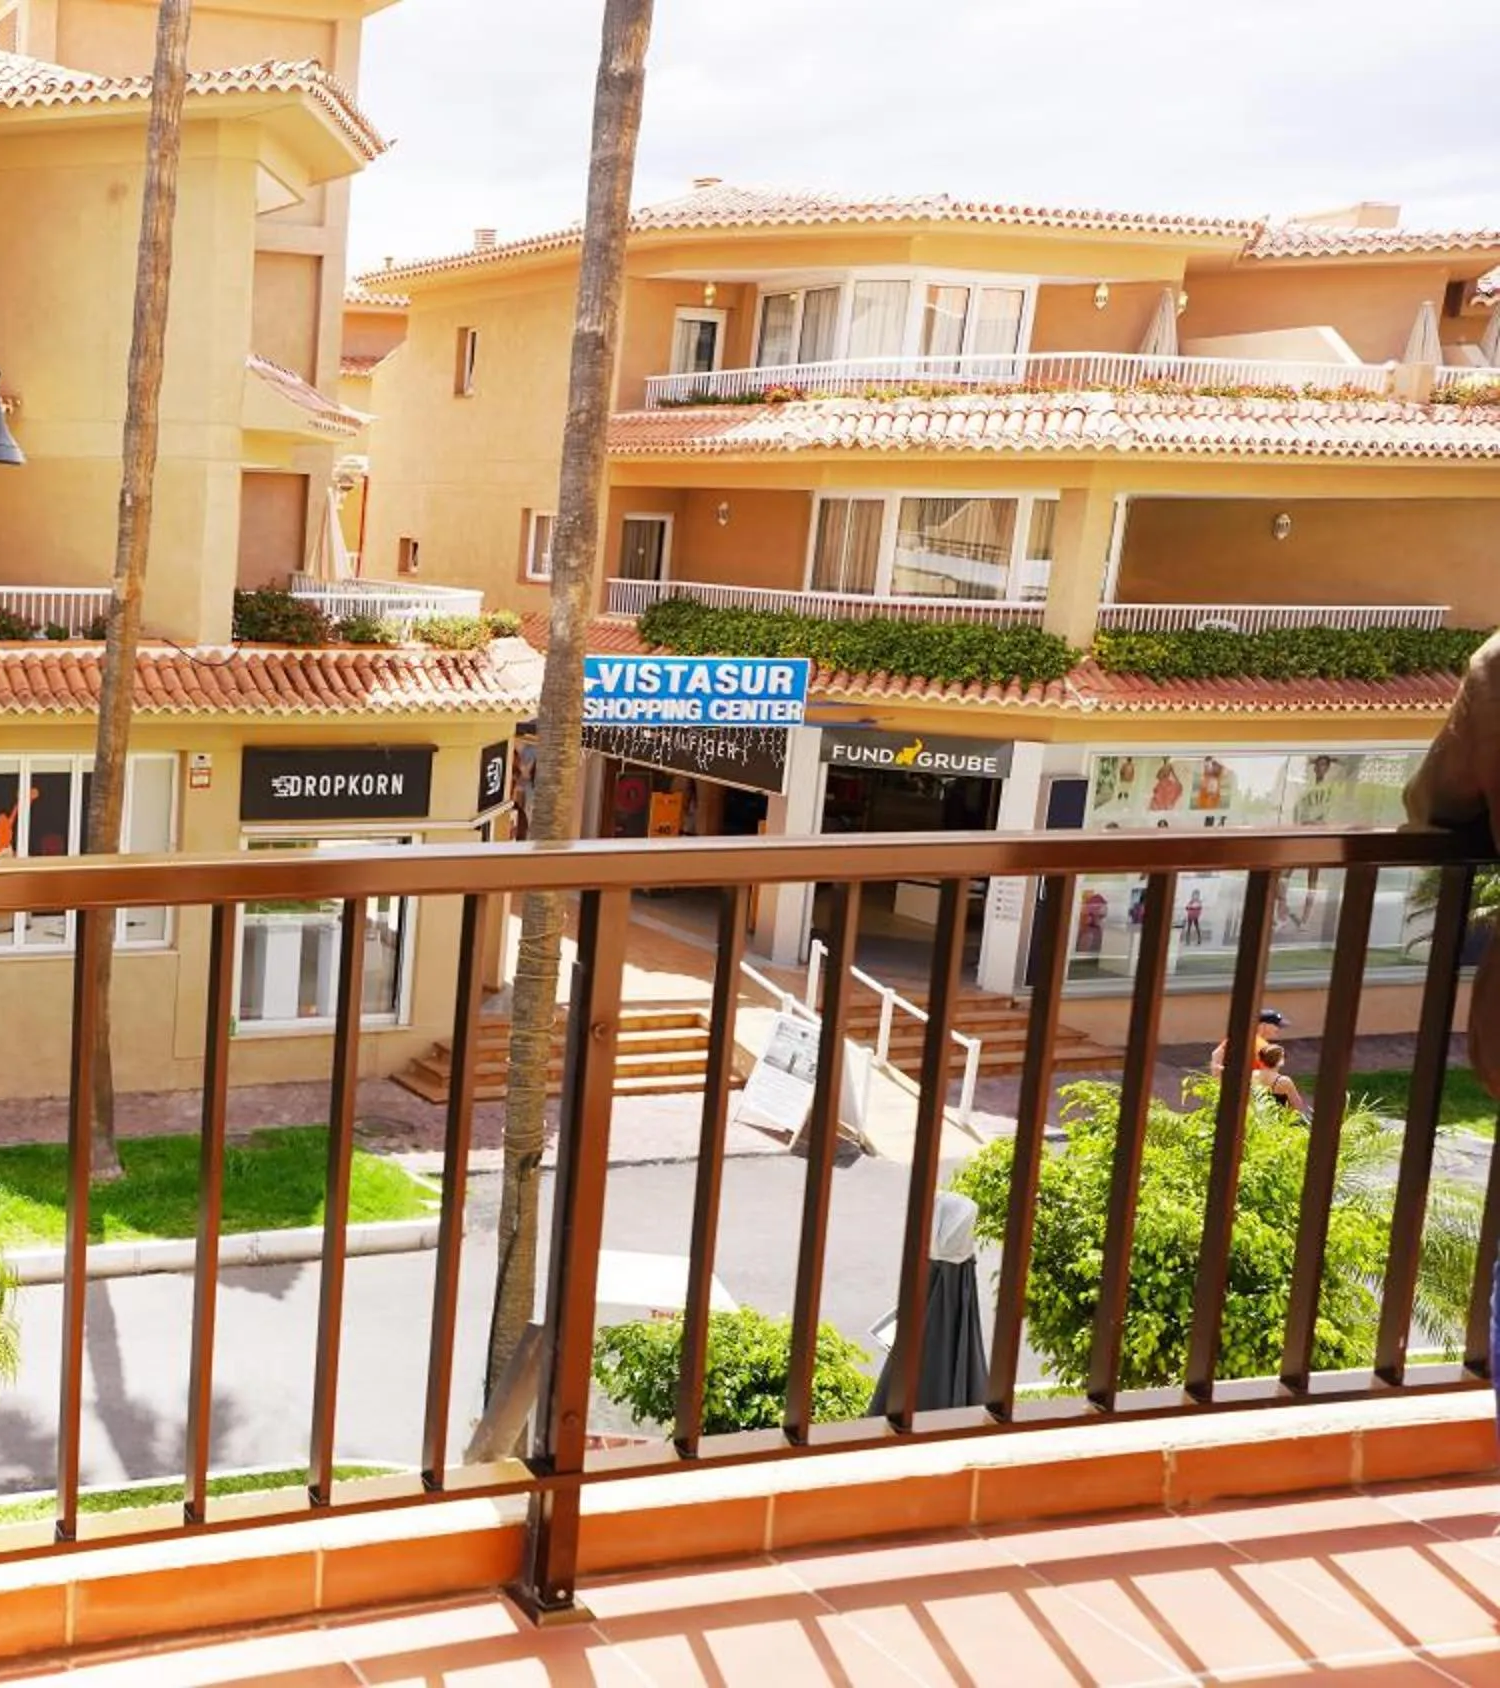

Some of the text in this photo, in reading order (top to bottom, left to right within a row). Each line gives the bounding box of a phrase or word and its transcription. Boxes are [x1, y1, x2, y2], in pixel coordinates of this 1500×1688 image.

[597, 663, 794, 695] VISTASUR
[583, 697, 803, 722] SHOPPING CENTER
[832, 744, 998, 774] FUND GRUBE
[289, 773, 404, 797] DROPKORN
